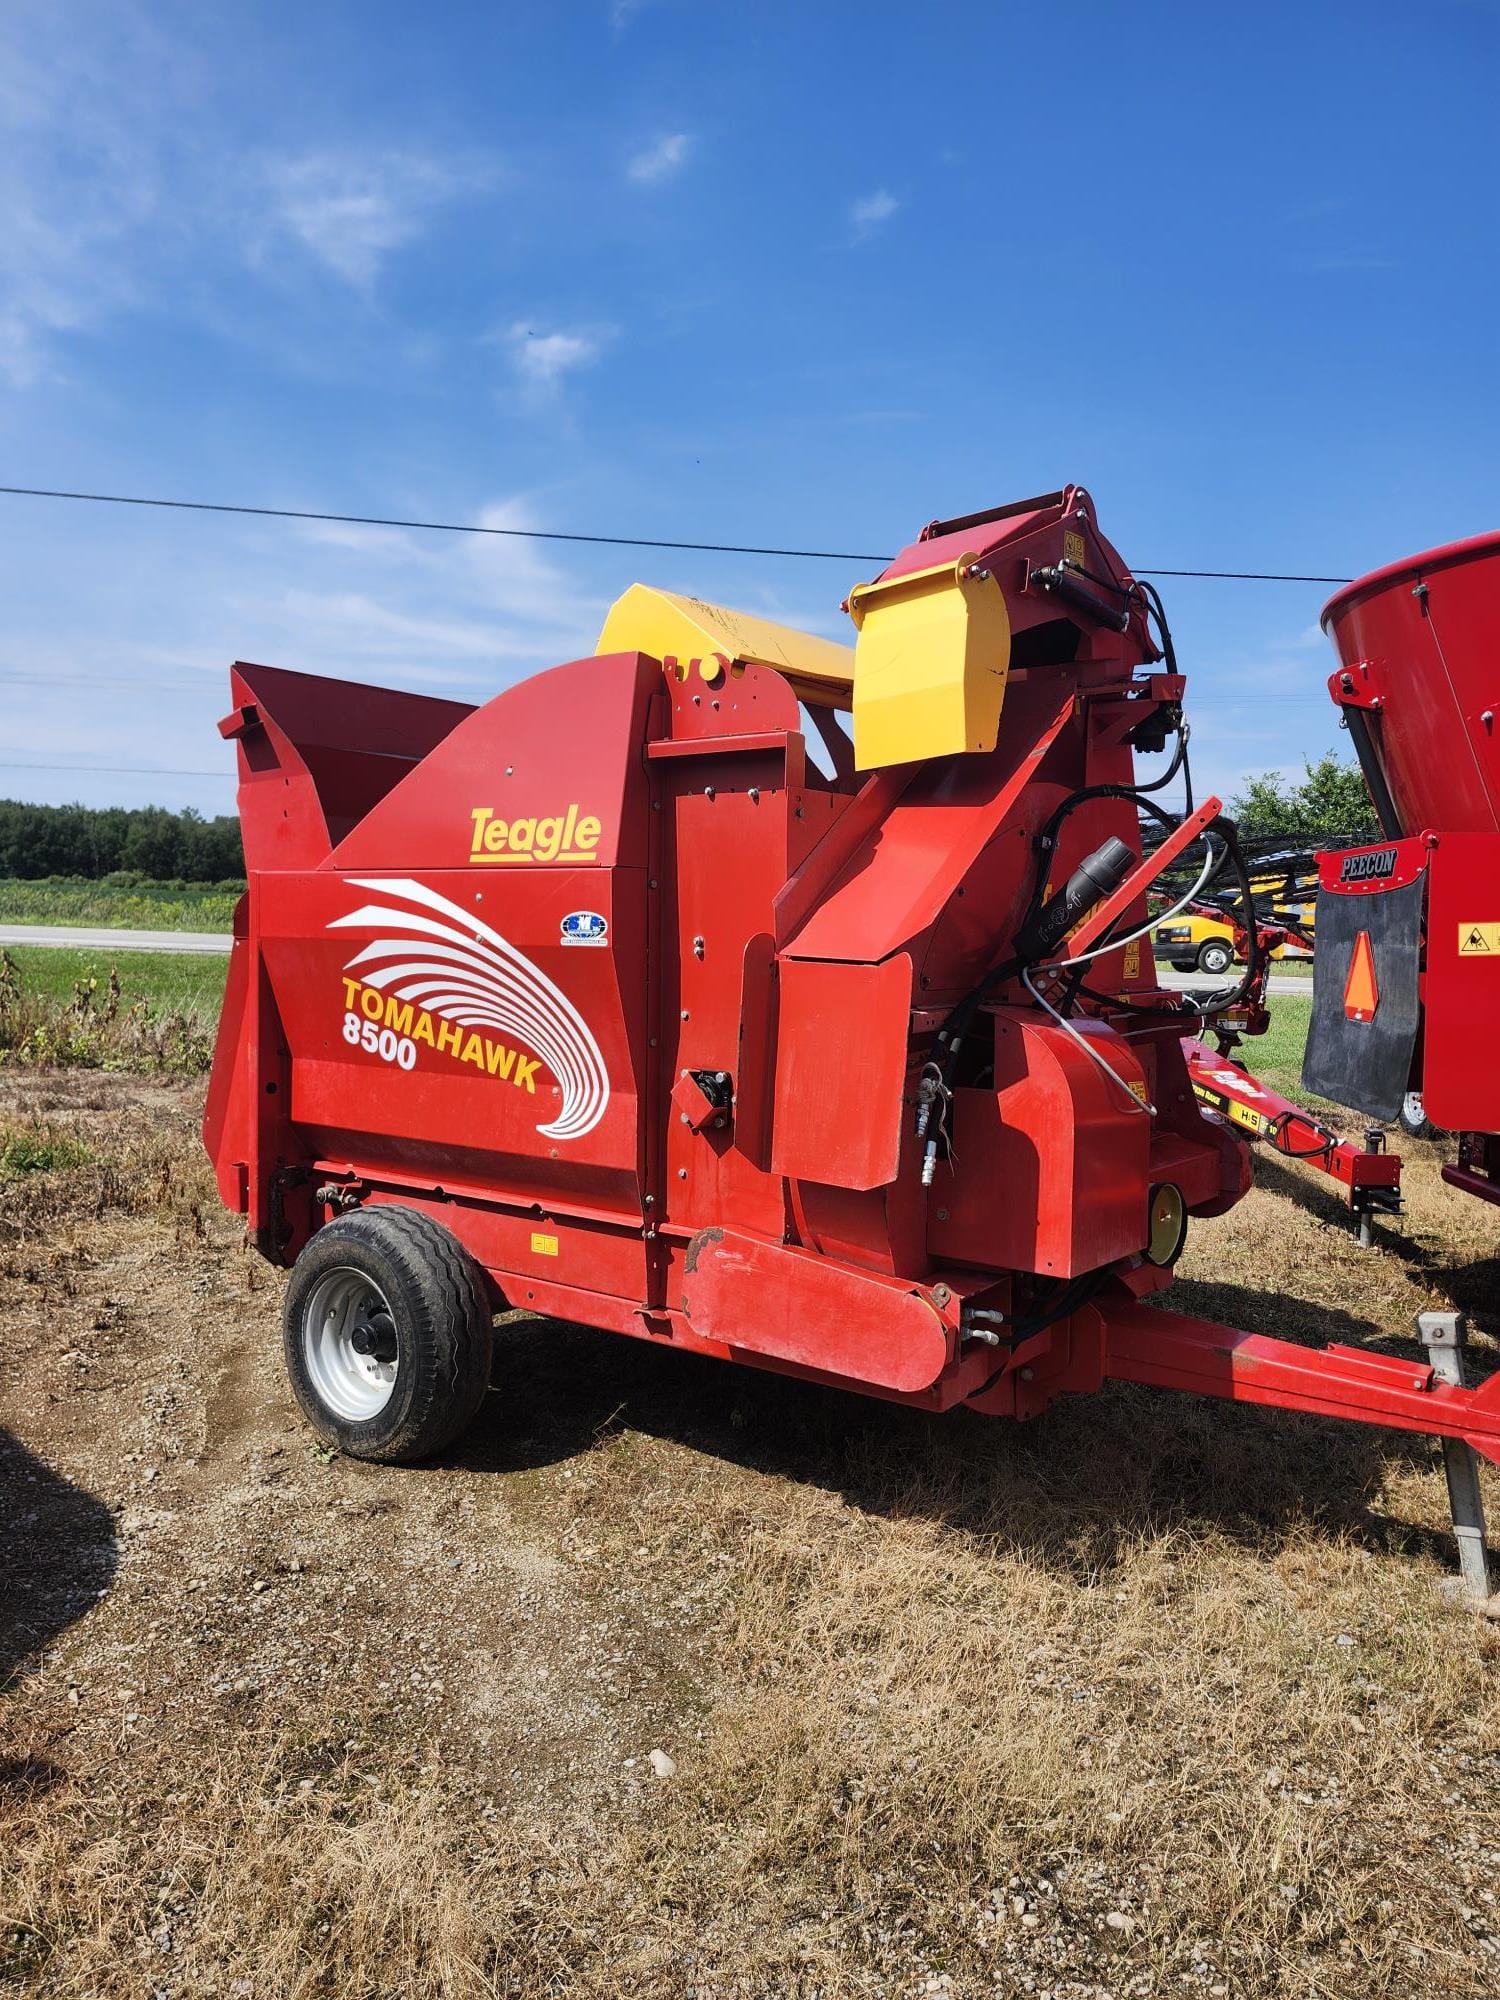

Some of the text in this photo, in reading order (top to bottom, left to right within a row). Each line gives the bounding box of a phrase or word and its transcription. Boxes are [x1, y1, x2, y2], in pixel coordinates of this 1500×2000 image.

[471, 804, 601, 860] Teagle
[1341, 849, 1397, 881] PEECON
[342, 976, 543, 1095] TOMAHAWK
[342, 1012, 417, 1071] 8500
